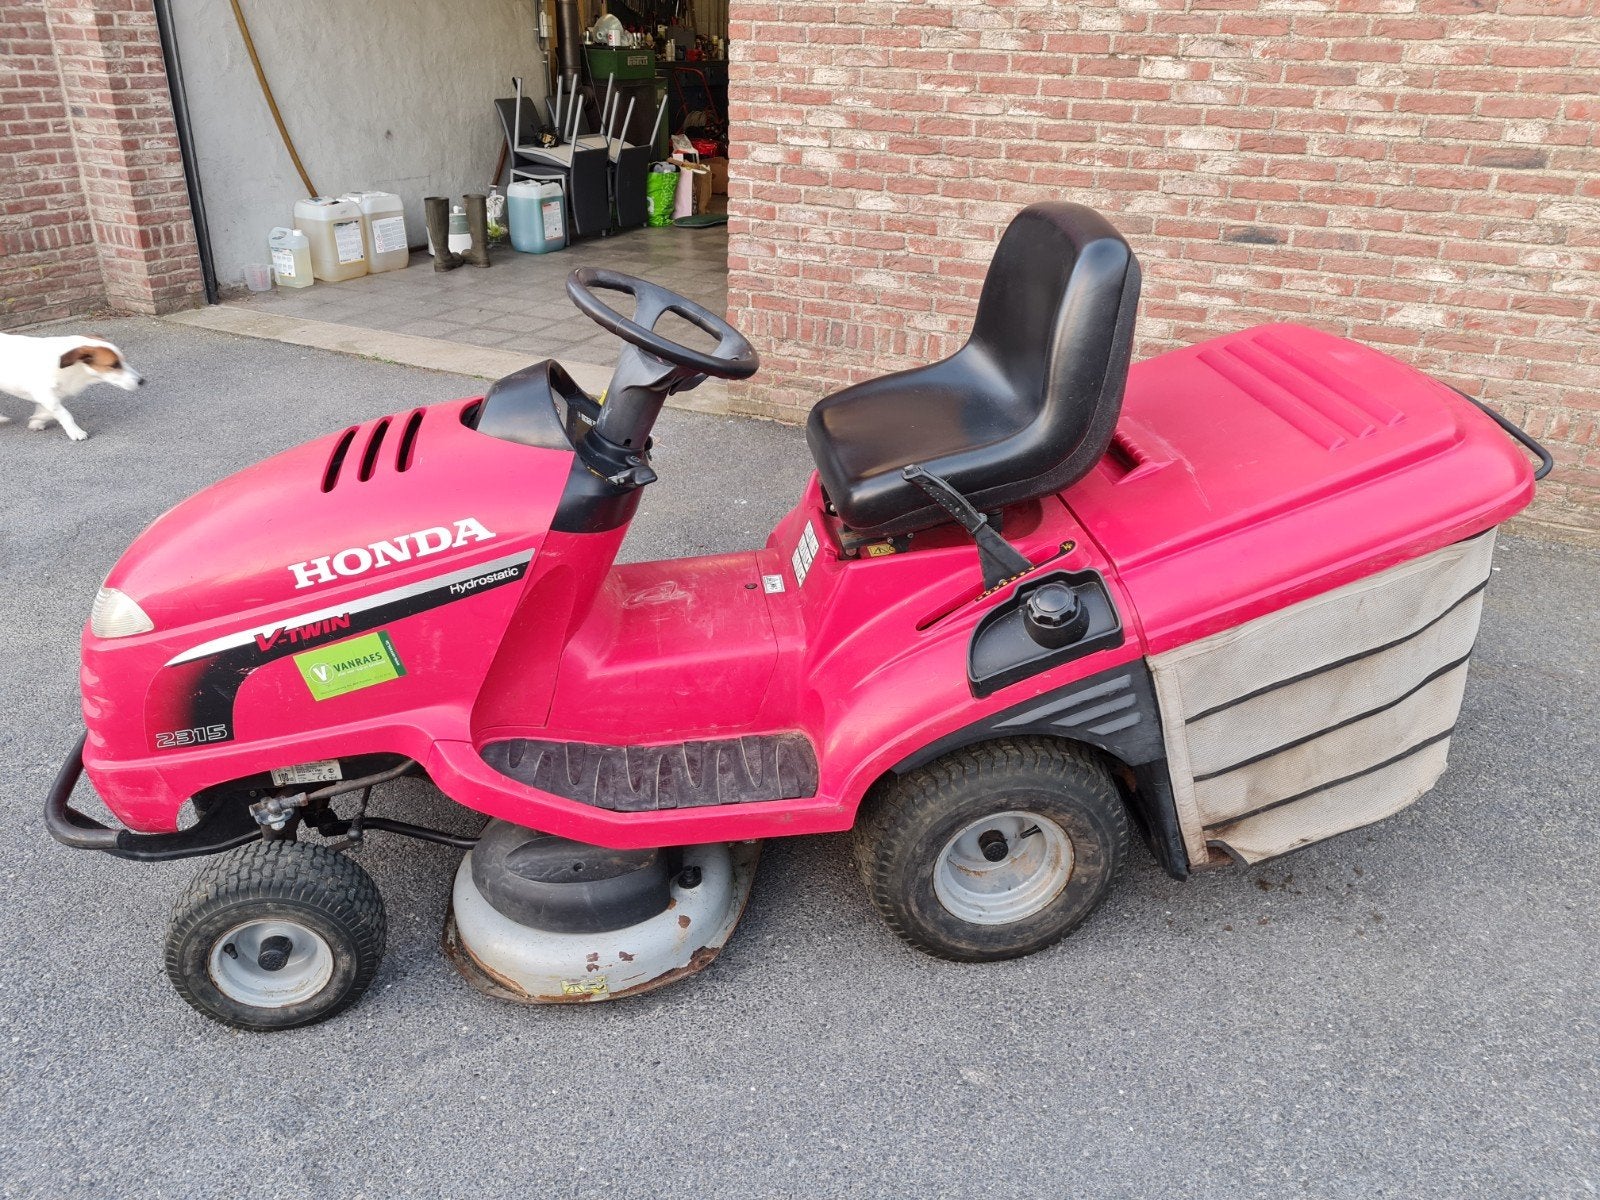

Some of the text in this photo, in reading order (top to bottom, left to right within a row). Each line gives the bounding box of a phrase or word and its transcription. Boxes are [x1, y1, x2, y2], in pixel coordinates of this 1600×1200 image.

[287, 516, 497, 589] HONDA
[449, 566, 519, 594] Hydrostatic
[254, 611, 351, 652] V-TWIN
[333, 651, 383, 672] VANRAES
[155, 723, 228, 748] 2315
